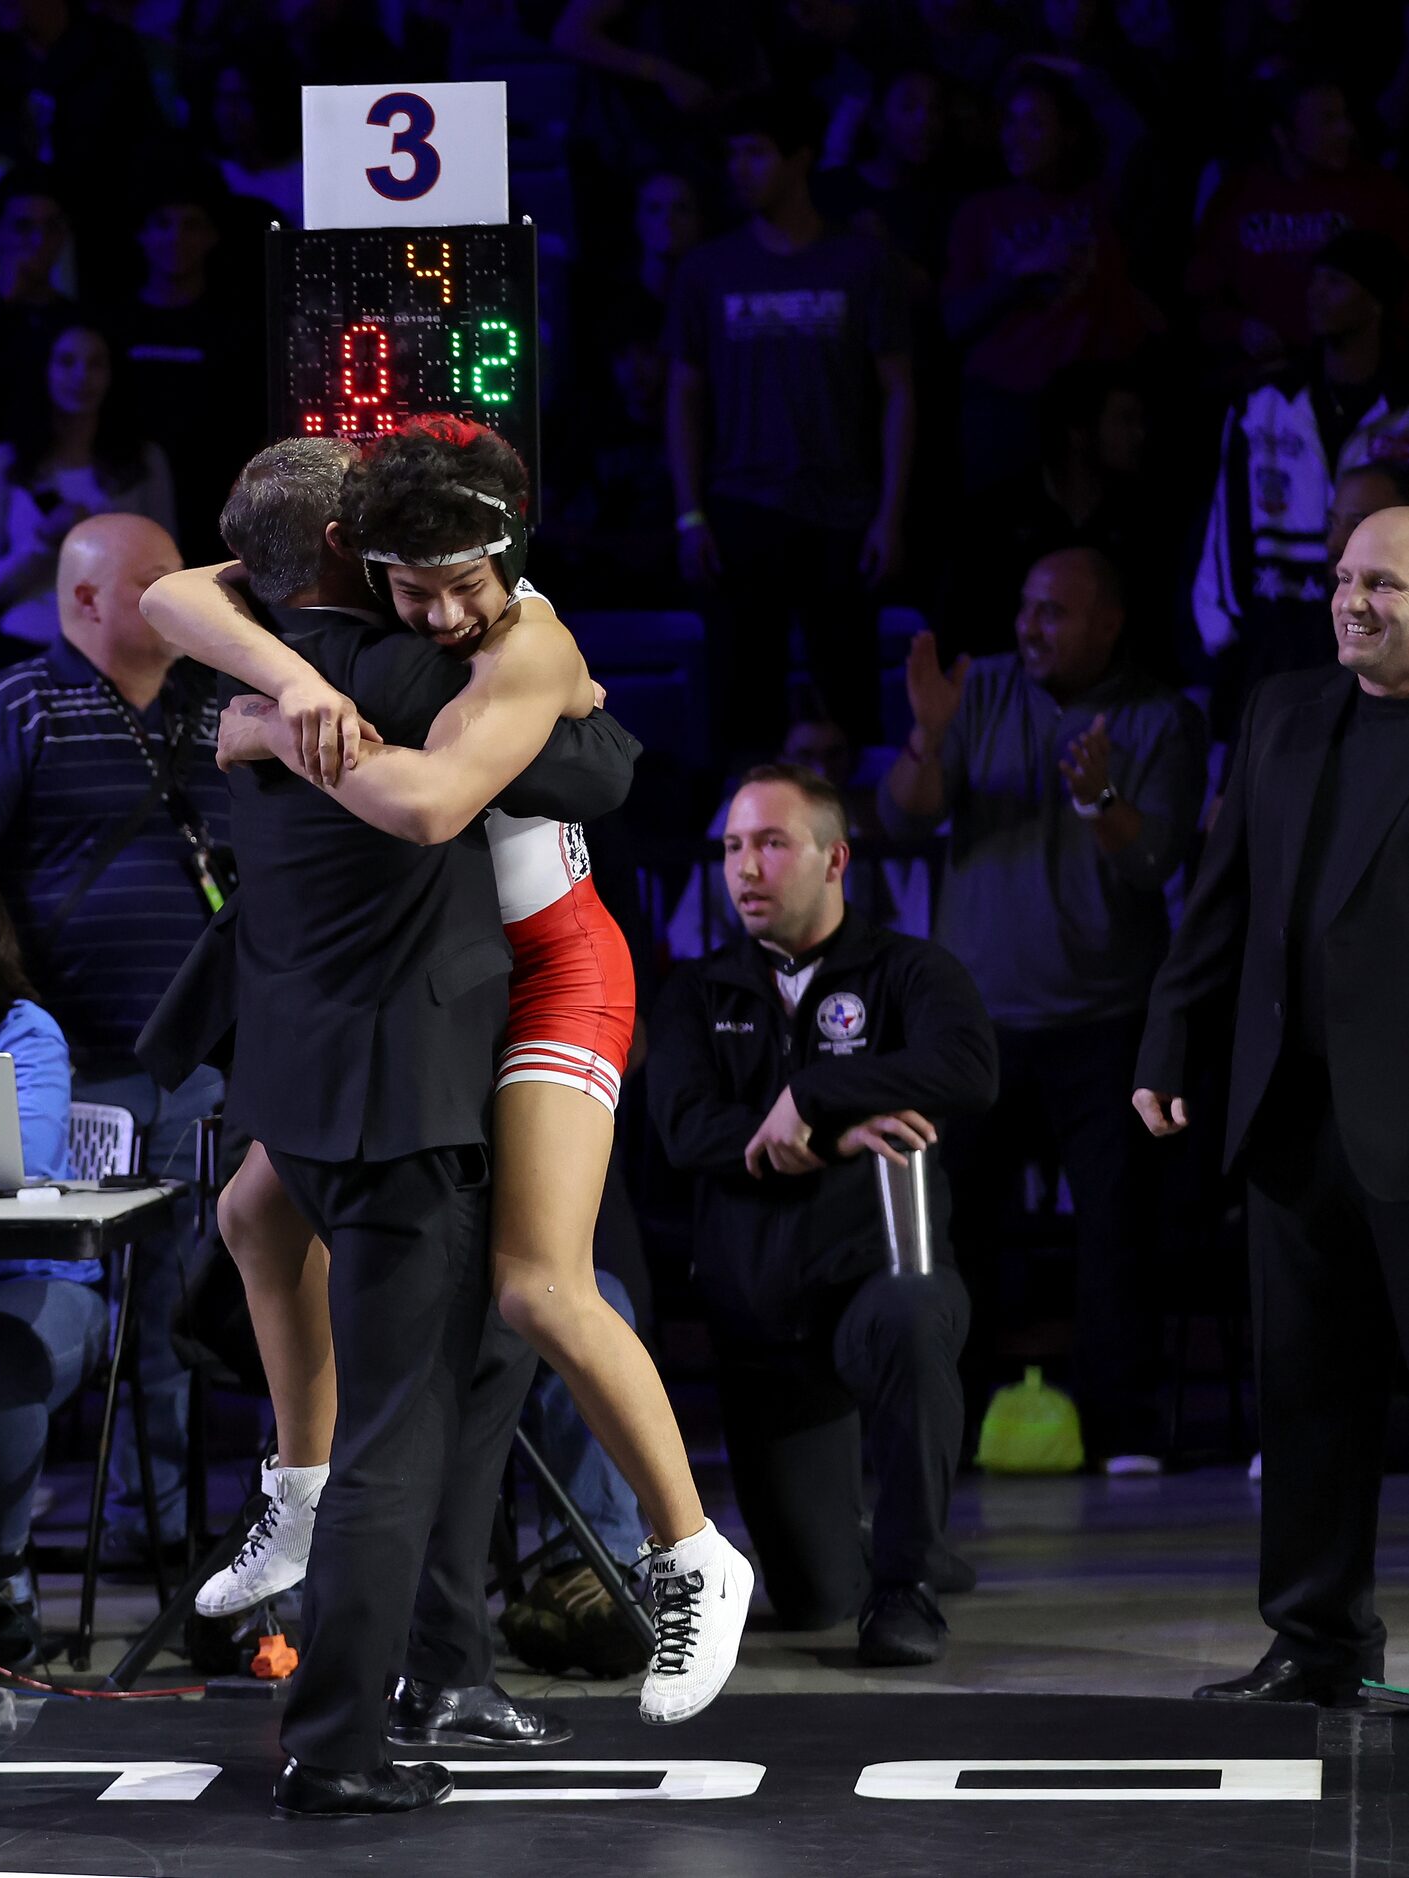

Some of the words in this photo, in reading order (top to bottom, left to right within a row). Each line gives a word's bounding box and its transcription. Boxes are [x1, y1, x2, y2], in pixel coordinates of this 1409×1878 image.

[366, 92, 441, 201] 3
[406, 243, 451, 304] 4
[362, 314, 389, 324] S/N:
[343, 324, 388, 404] 0
[452, 320, 518, 403] 12
[653, 1559, 676, 1573] NIKE
